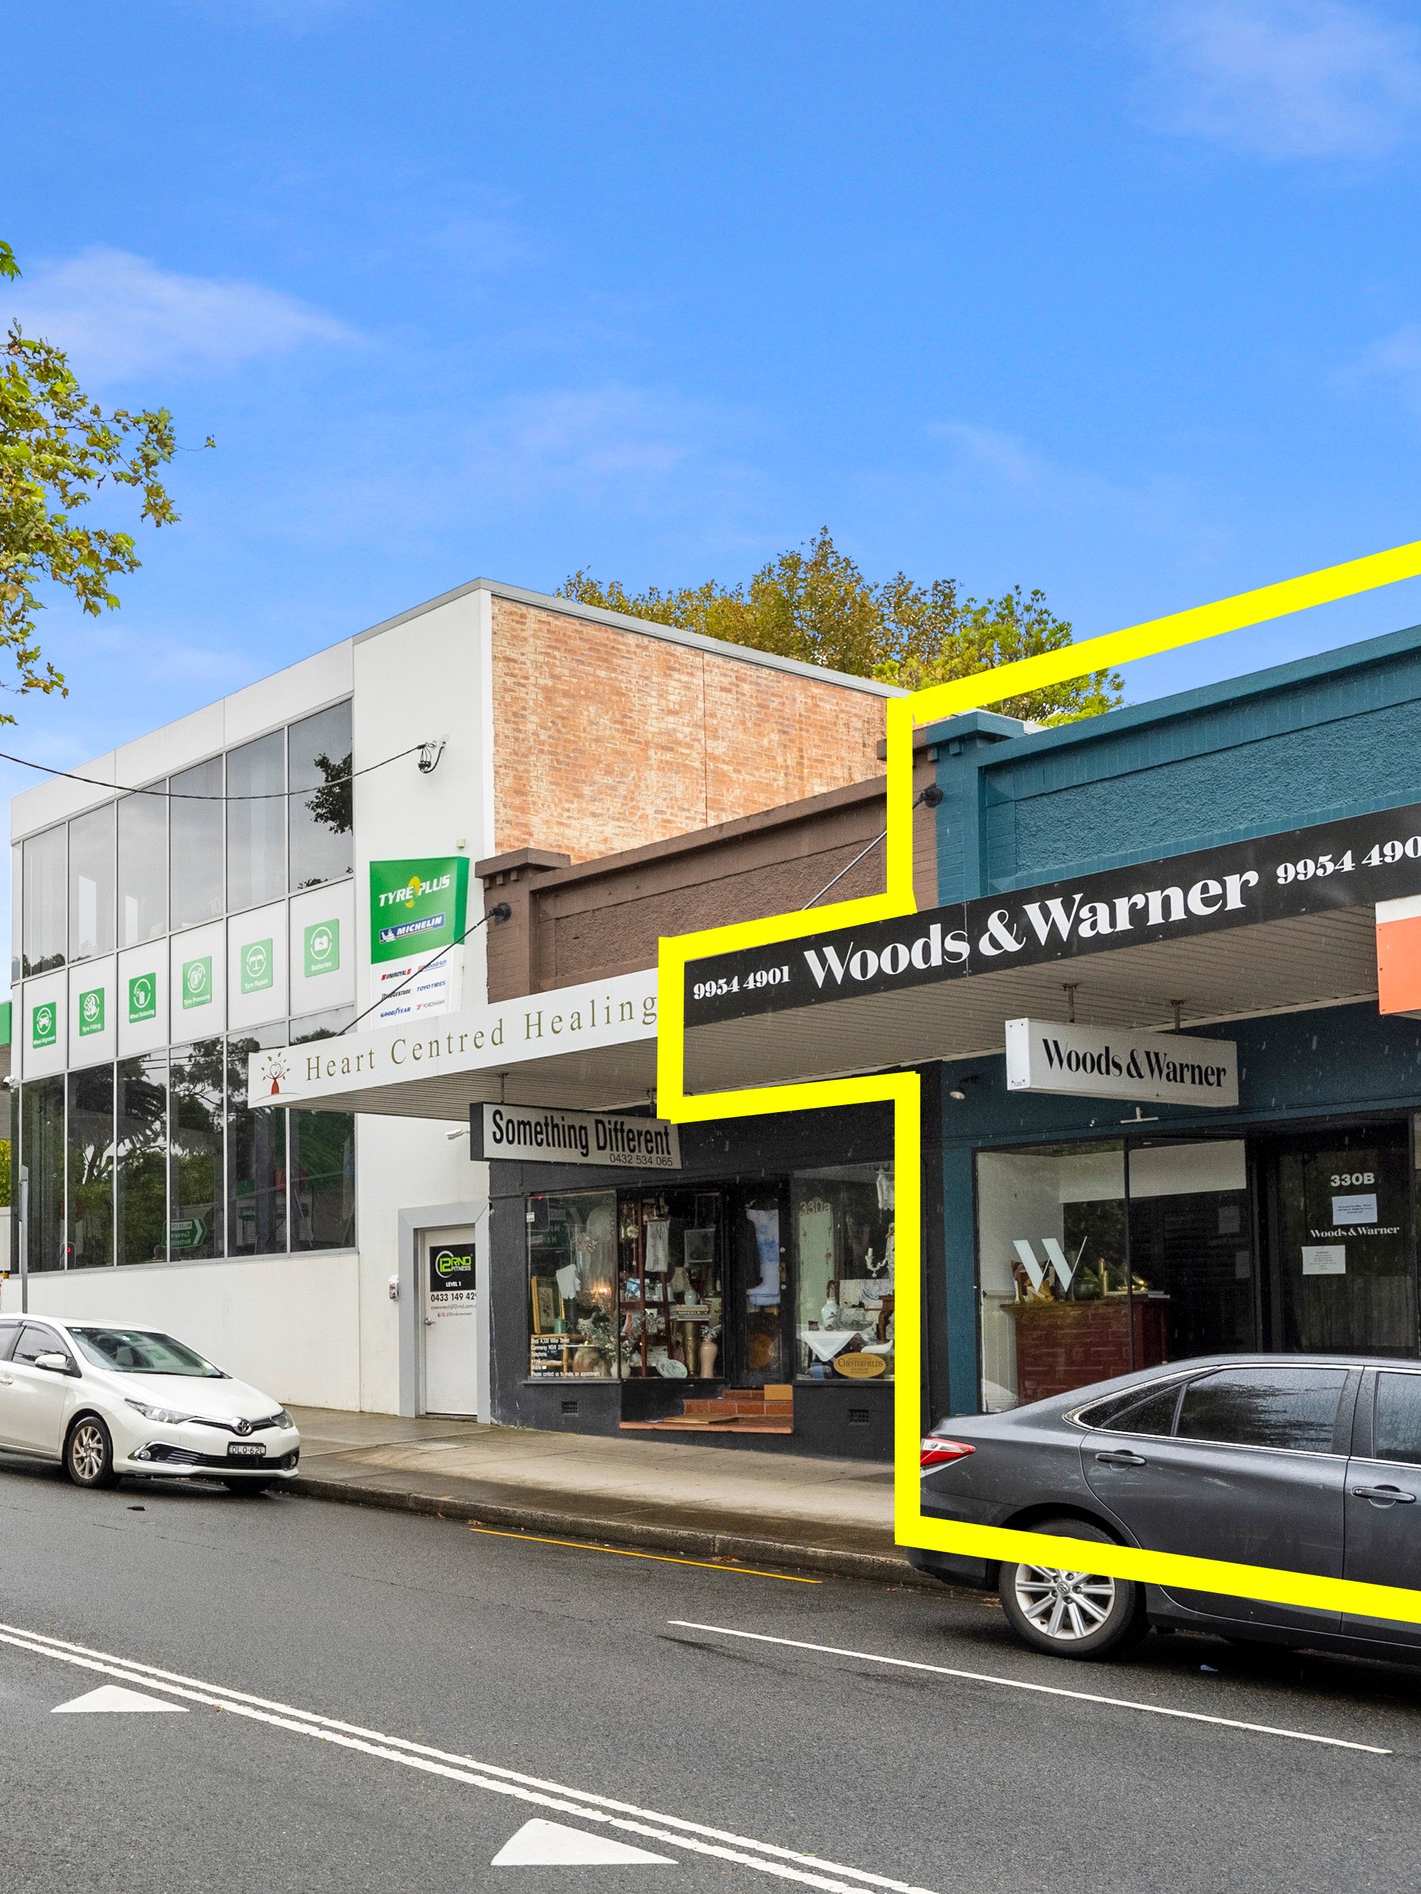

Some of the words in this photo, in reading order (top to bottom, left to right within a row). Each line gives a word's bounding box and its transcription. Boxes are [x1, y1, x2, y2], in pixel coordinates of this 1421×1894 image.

[1276, 849, 1356, 885] 9954
[396, 916, 443, 935] MICHELIN
[803, 922, 971, 990] Woods
[1022, 869, 1260, 947] Warner
[693, 976, 740, 1000] 9954
[743, 965, 791, 988] 4901
[305, 1048, 375, 1081] Heart
[391, 1018, 505, 1065] Centred
[523, 995, 658, 1041] Healing
[1041, 1038, 1123, 1078] Woods
[1144, 1050, 1227, 1088] Warner
[492, 1109, 590, 1158] Something
[594, 1118, 672, 1156] Different
[609, 1153, 634, 1164] 0432
[636, 1155, 654, 1165] 534
[655, 1156, 674, 1167] 065
[1330, 1172, 1376, 1187] 330B
[799, 1200, 832, 1217] 330a
[1310, 1227, 1347, 1239] Woods
[1357, 1225, 1401, 1237] Warner
[431, 1293, 449, 1302] 0433
[451, 1292, 464, 1301] 149
[465, 1292, 477, 1301] 42
